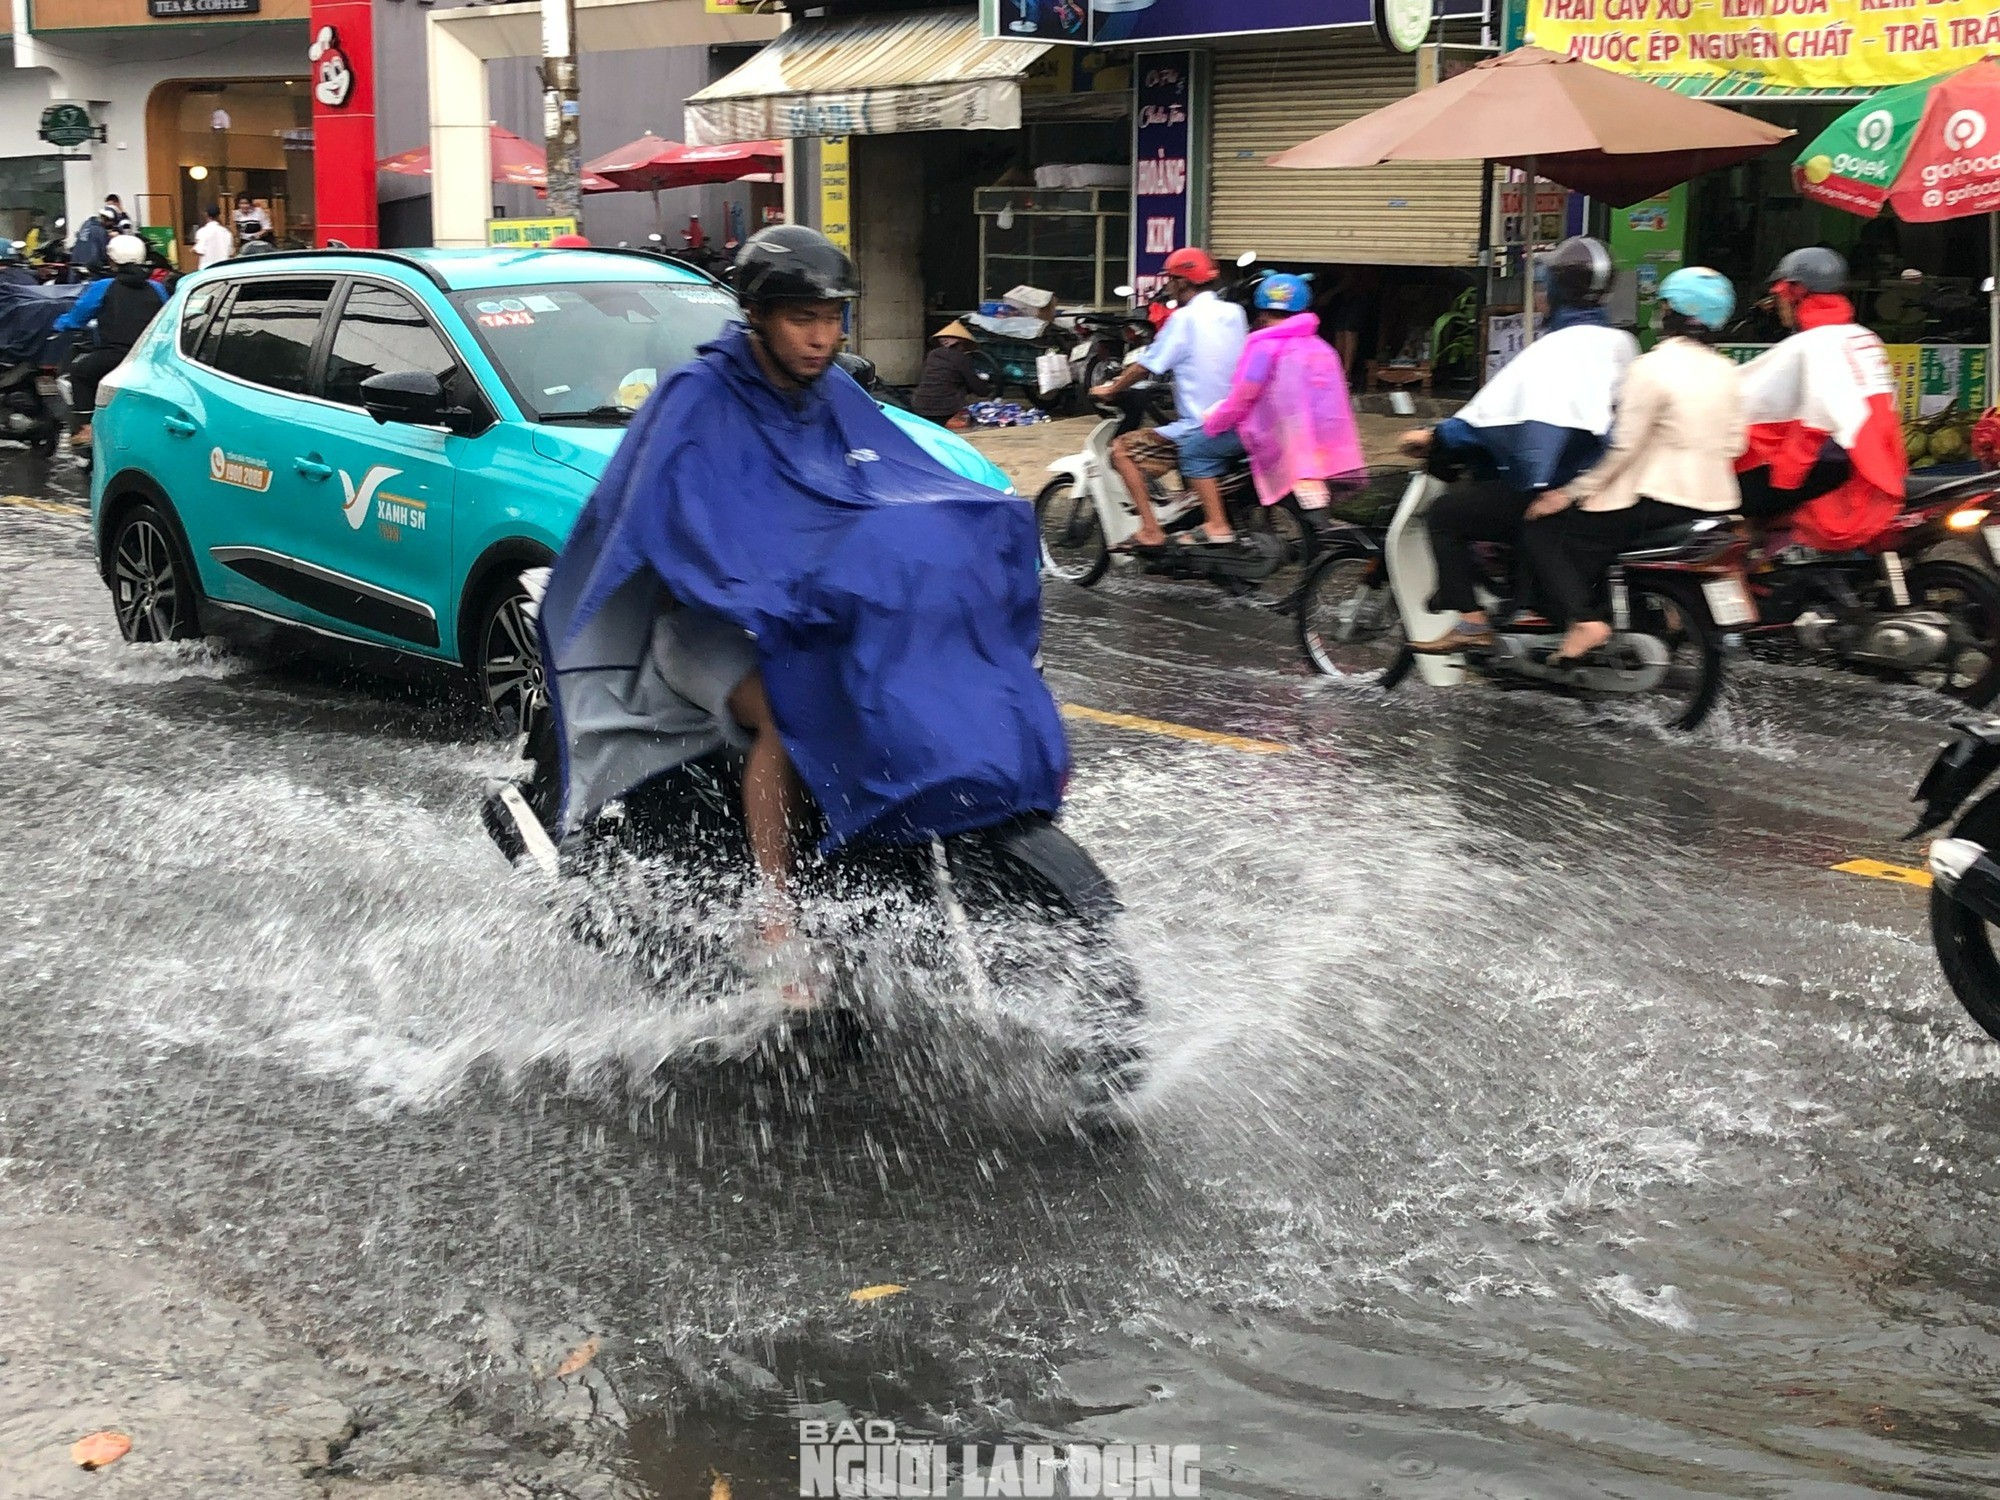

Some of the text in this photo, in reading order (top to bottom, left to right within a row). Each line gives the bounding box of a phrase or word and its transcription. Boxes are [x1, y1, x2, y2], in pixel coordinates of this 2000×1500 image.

[156, 1, 181, 13] TEA
[1568, 30, 1641, 62] NƯỚC
[1648, 29, 1681, 62] ÉP
[1884, 18, 1939, 53] TRÀ
[478, 311, 535, 327] TAXI
[377, 500, 426, 531] XANH SM
